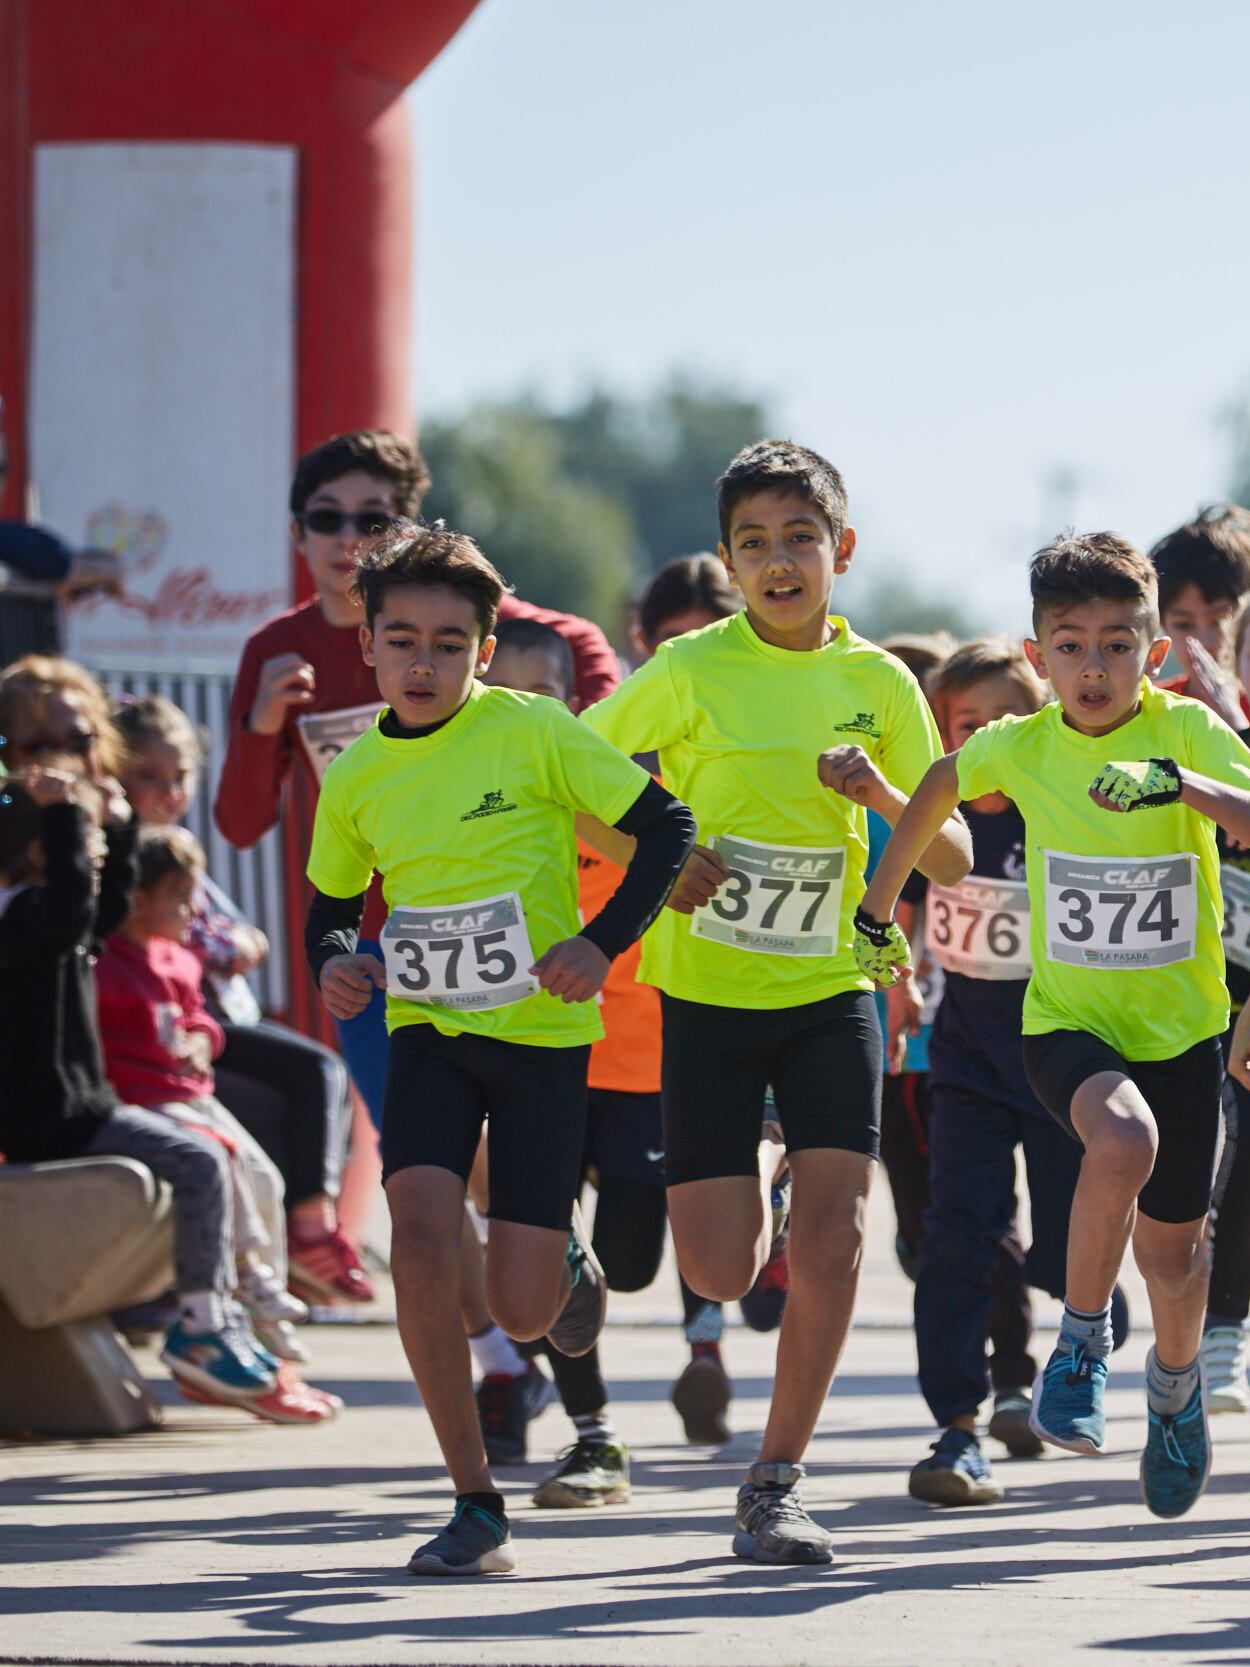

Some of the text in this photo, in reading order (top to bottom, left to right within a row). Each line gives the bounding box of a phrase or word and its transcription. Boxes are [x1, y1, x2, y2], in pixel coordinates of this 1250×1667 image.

[770, 857, 831, 874] CLAF
[1103, 866, 1172, 886] CLAF
[711, 868, 831, 932] 377
[1058, 889, 1180, 945] 374
[431, 910, 494, 933] CLAF
[934, 900, 1020, 958] 376
[394, 930, 516, 991] 375
[1100, 951, 1150, 961] LA PASADA
